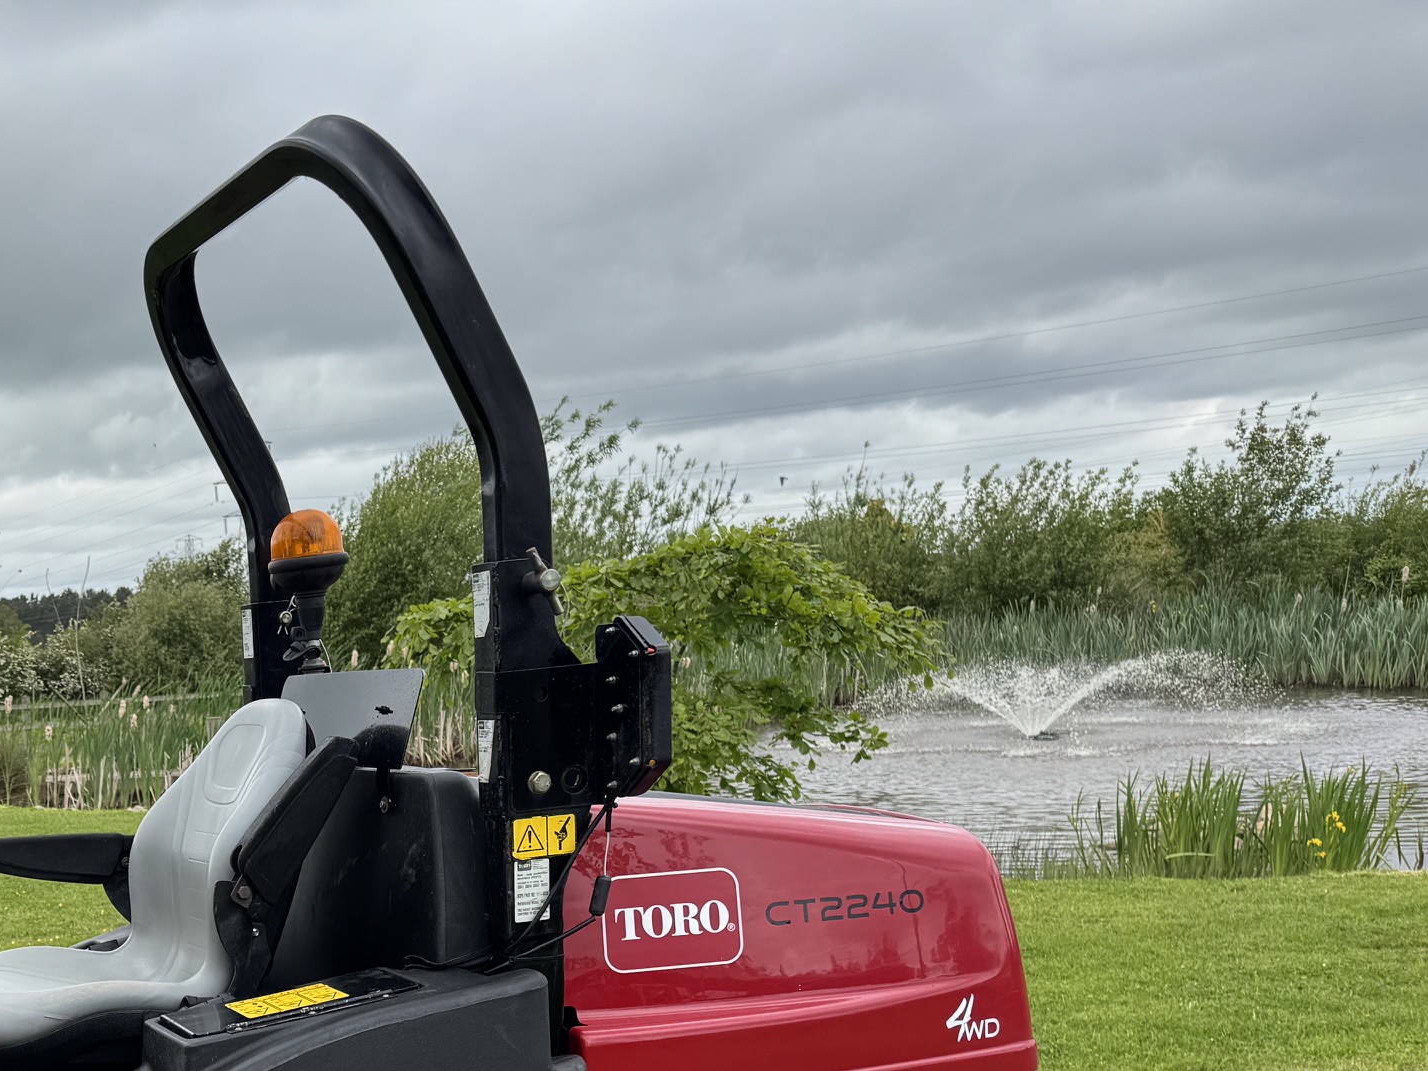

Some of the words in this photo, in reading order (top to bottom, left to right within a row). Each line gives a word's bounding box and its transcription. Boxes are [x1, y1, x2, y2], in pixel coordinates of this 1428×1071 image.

[614, 900, 729, 941] TORO
[765, 889, 924, 926] CT2240
[945, 993, 1000, 1042] 4WD
